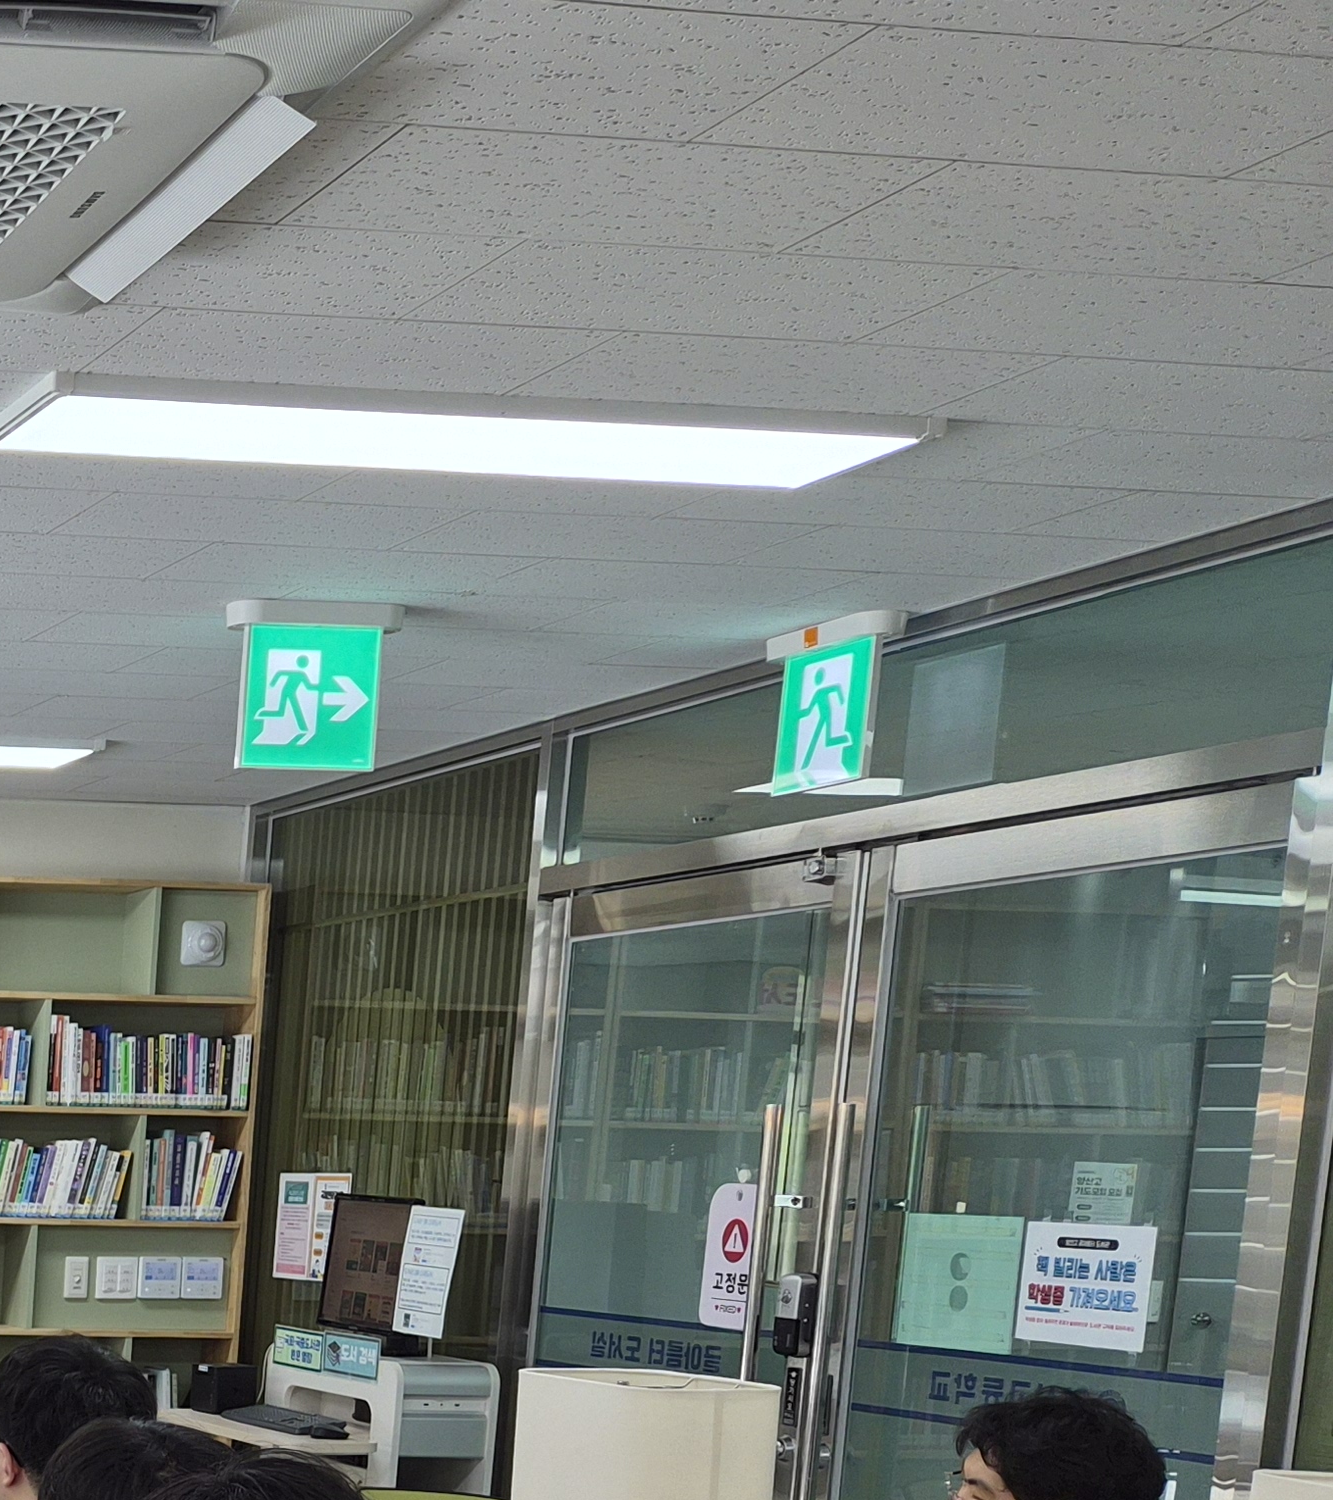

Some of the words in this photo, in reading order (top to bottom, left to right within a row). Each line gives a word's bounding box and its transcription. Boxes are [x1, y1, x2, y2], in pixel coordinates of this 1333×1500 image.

[1036, 1255, 1050, 1277] 책
[1052, 1256, 1091, 1280] 빌리는
[1093, 1258, 1137, 1284] 사람은
[712, 1272, 749, 1296] 고정문
[1027, 1282, 1066, 1307] 학생증
